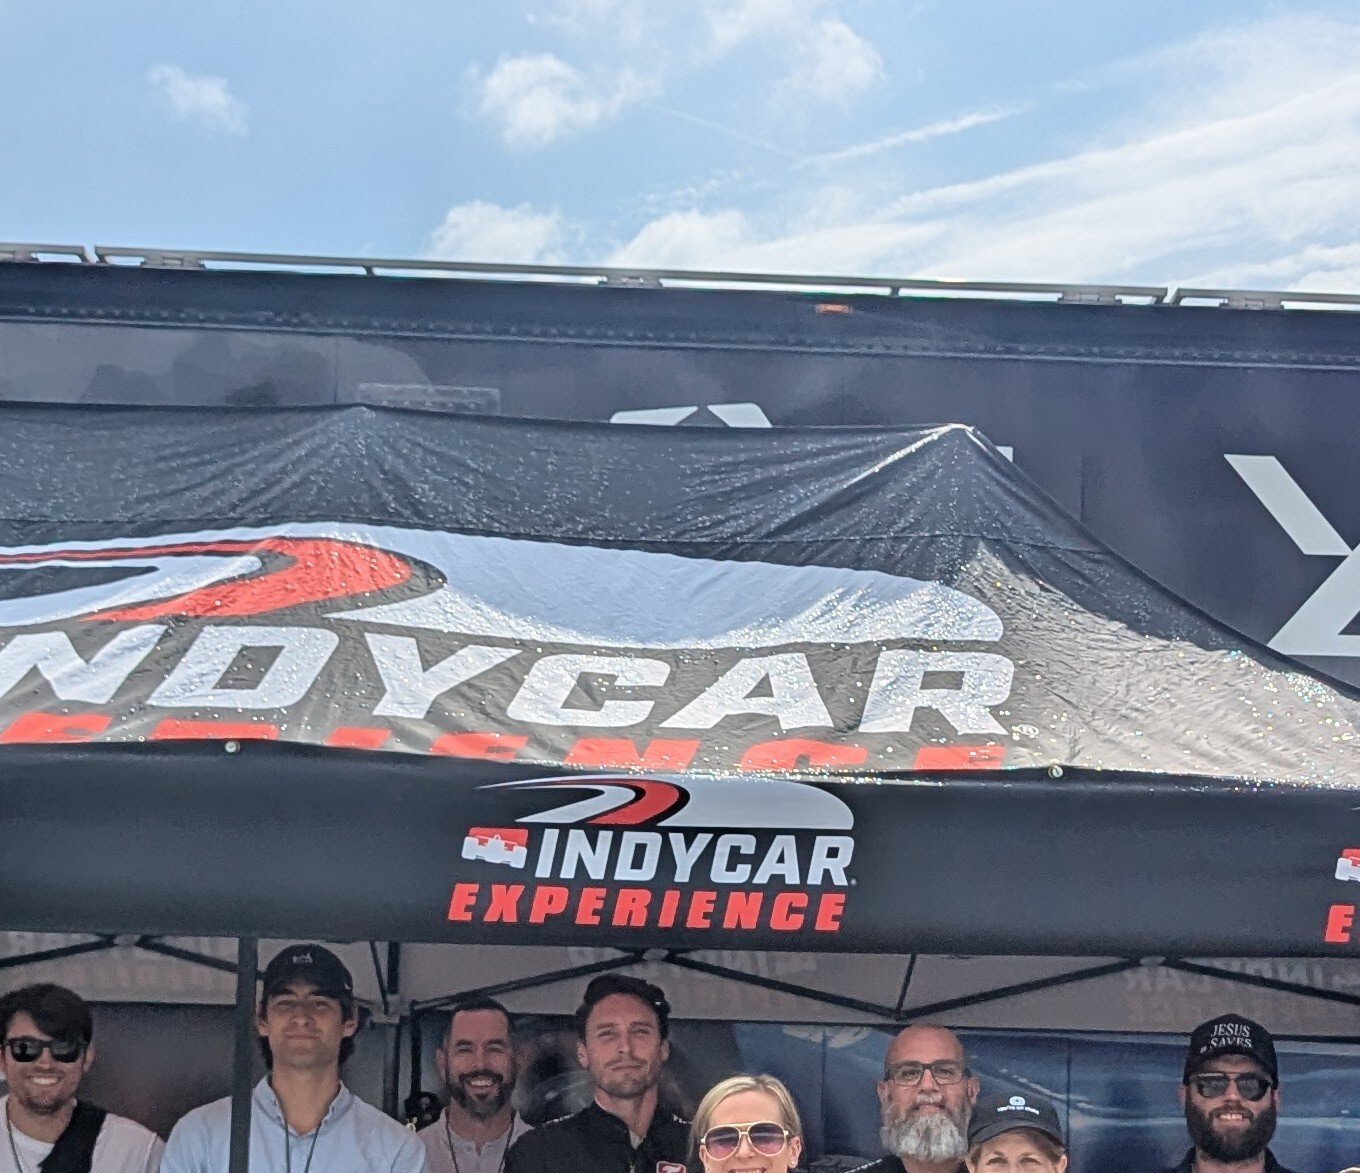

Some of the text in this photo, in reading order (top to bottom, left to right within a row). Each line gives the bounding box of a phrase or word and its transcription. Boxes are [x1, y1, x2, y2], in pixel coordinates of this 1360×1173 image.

[535, 827, 855, 887] INDYCAR
[447, 881, 847, 933] EXPERIENCE
[1211, 1023, 1251, 1038] JESUS
